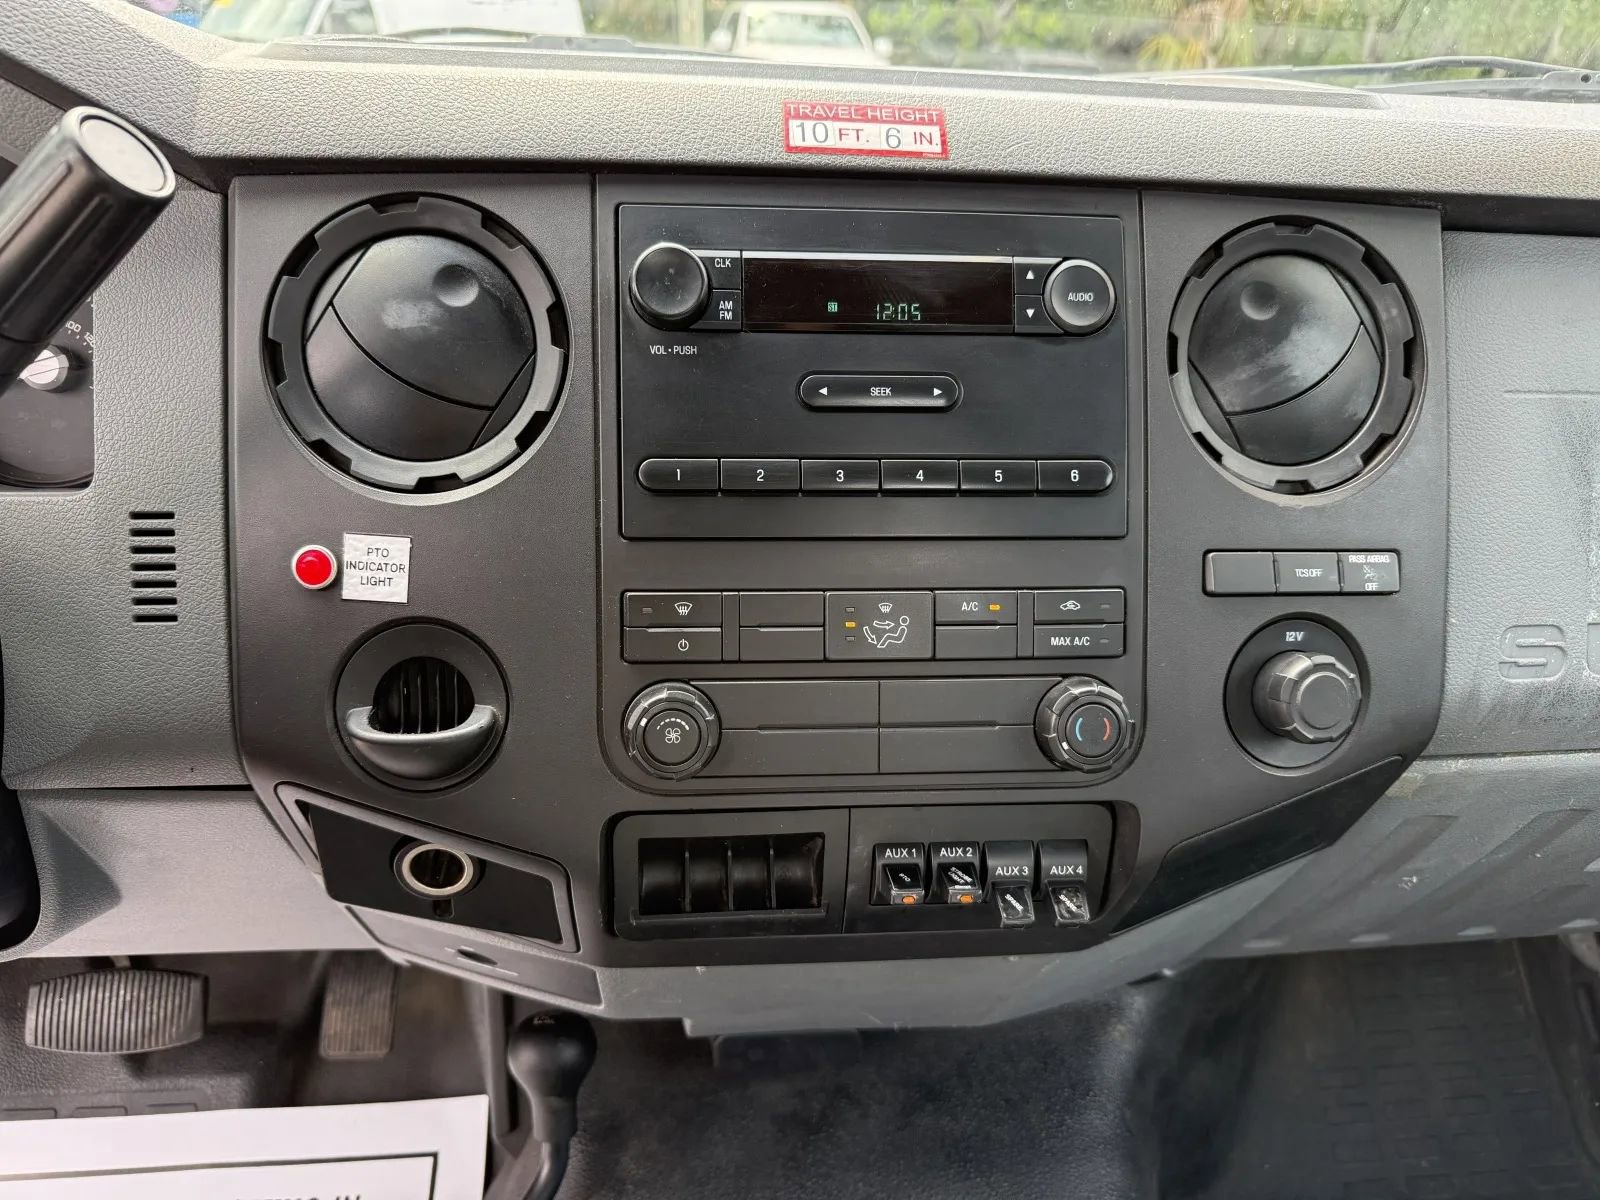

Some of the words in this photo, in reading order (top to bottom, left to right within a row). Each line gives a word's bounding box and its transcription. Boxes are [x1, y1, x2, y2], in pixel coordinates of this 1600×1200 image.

[787, 103, 863, 119] TRAVEL
[868, 106, 941, 123] HEIGHT
[796, 121, 829, 144] 10
[838, 127, 870, 143] FT.
[885, 127, 902, 149] 6
[913, 131, 940, 147] IN.
[714, 258, 732, 268] CLK
[1067, 292, 1094, 302] AUDIO
[718, 300, 733, 310] AM
[719, 311, 733, 320] FM
[875, 303, 921, 321] 12:05
[649, 345, 668, 355] VOL
[673, 345, 698, 355] PUSH
[870, 386, 892, 397] SEEK
[676, 468, 681, 481] 1
[756, 469, 765, 482] 2
[836, 469, 845, 482] 3
[915, 469, 925, 482] 4
[994, 470, 1003, 483] 5
[1070, 469, 1080, 482] 6
[367, 547, 390, 558] PTO
[345, 560, 406, 574] INDICATOR
[1309, 568, 1324, 577] OFF
[360, 576, 394, 587] LIGHT
[1364, 582, 1379, 591] OFF
[961, 601, 979, 612] A/C
[1050, 636, 1071, 646] MAX
[1073, 636, 1091, 646] A/C
[1285, 631, 1304, 642] 12V
[884, 847, 909, 858] AUX
[911, 848, 917, 858] 1
[940, 847, 964, 857] AUX
[965, 846, 973, 857] 2
[995, 866, 1020, 876] AUX
[1021, 865, 1029, 875] 3
[1049, 865, 1074, 875] AUX
[1075, 865, 1084, 875] 4
[1004, 893, 1024, 912] SPARE
[1058, 894, 1078, 912] SPARE
